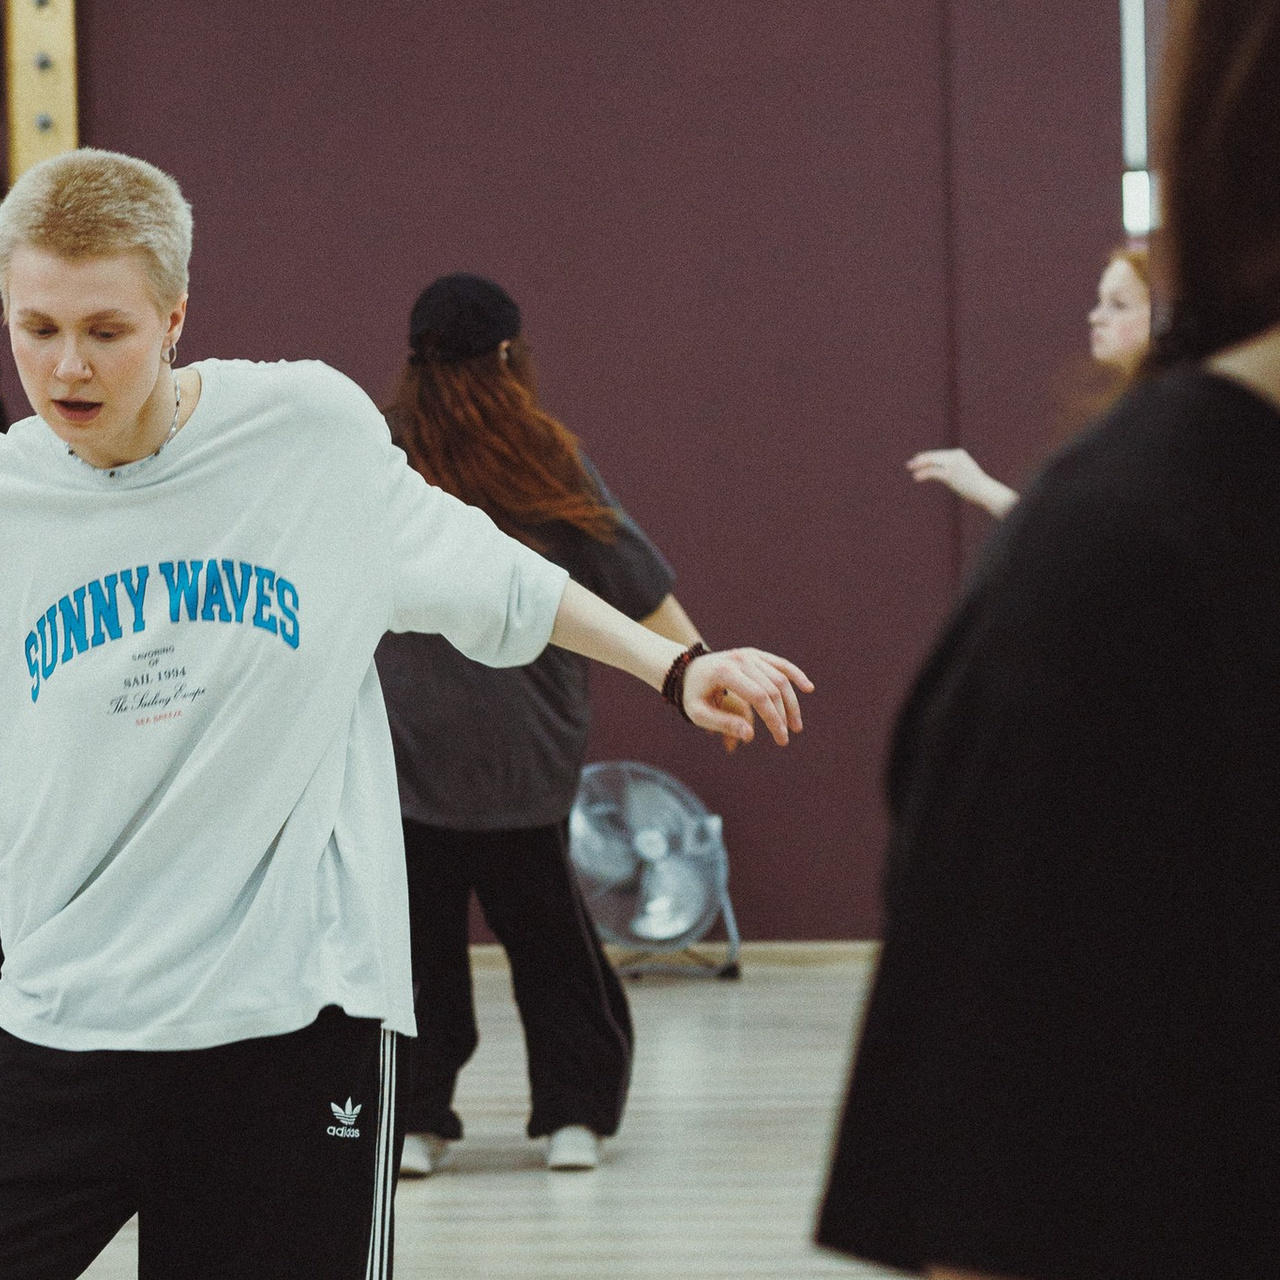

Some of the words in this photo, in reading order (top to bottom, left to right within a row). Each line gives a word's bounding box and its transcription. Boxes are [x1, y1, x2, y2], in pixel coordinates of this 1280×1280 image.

[24, 565, 149, 703] SUNNY
[159, 558, 300, 650] WAVES
[158, 666, 186, 682] 1994
[107, 694, 129, 715] The
[131, 690, 171, 708] Sailing
[326, 1125, 360, 1138] adidas
